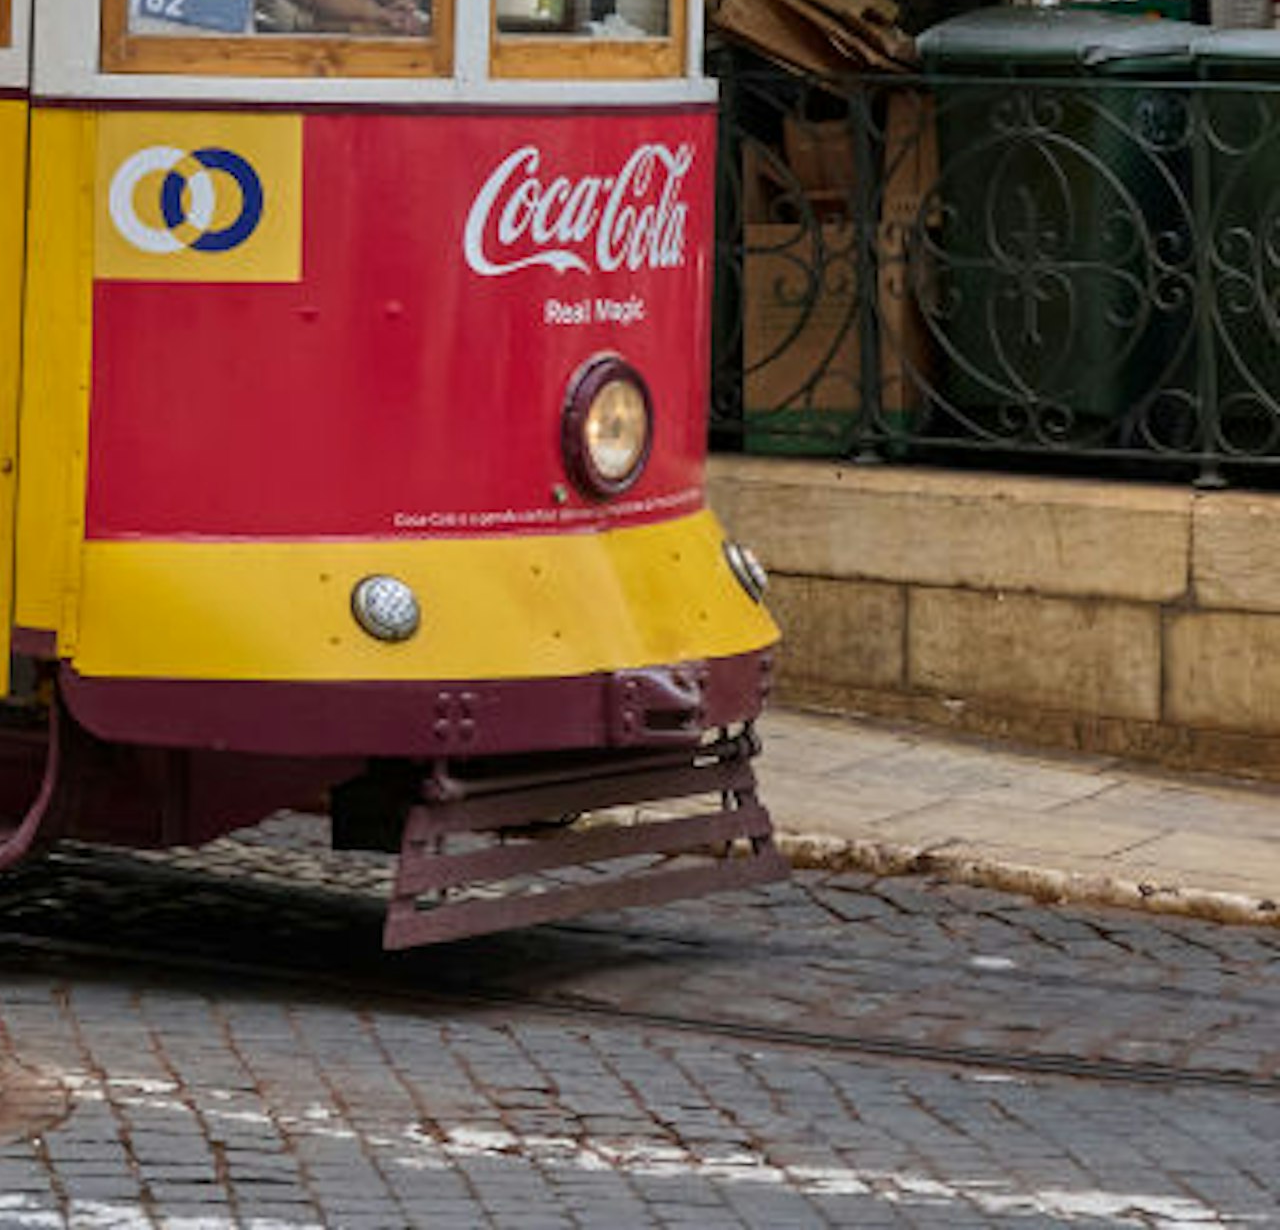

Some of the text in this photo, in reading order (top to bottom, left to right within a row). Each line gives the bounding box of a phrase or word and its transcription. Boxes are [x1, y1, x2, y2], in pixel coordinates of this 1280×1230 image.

[463, 143, 695, 276] Coca-Cola
[545, 294, 645, 325] Real Magic
